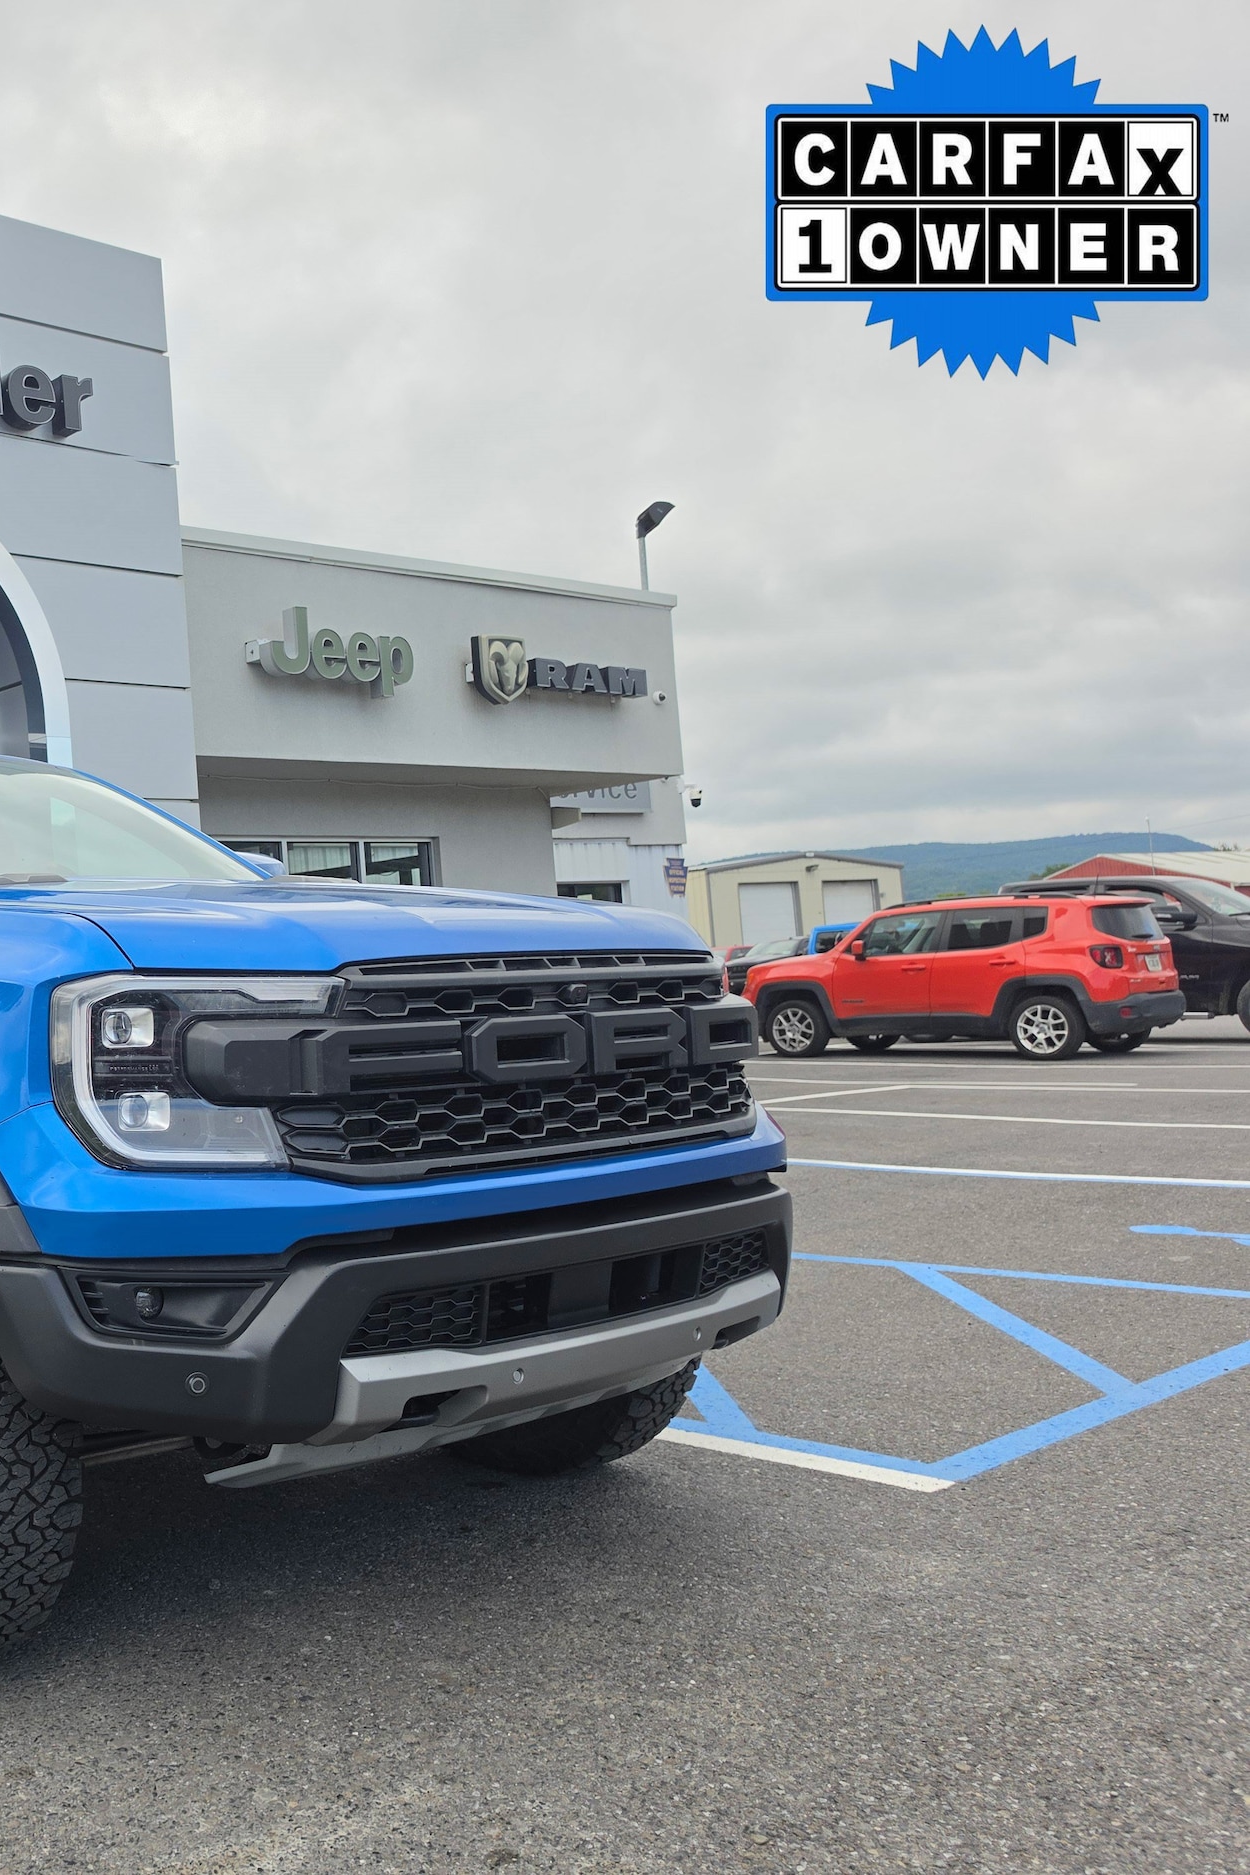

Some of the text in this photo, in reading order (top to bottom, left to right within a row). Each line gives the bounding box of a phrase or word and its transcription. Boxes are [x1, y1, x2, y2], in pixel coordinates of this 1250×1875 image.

[260, 606, 414, 698] Jeep
[527, 657, 648, 699] RAM
[310, 1002, 757, 1098] FORD
